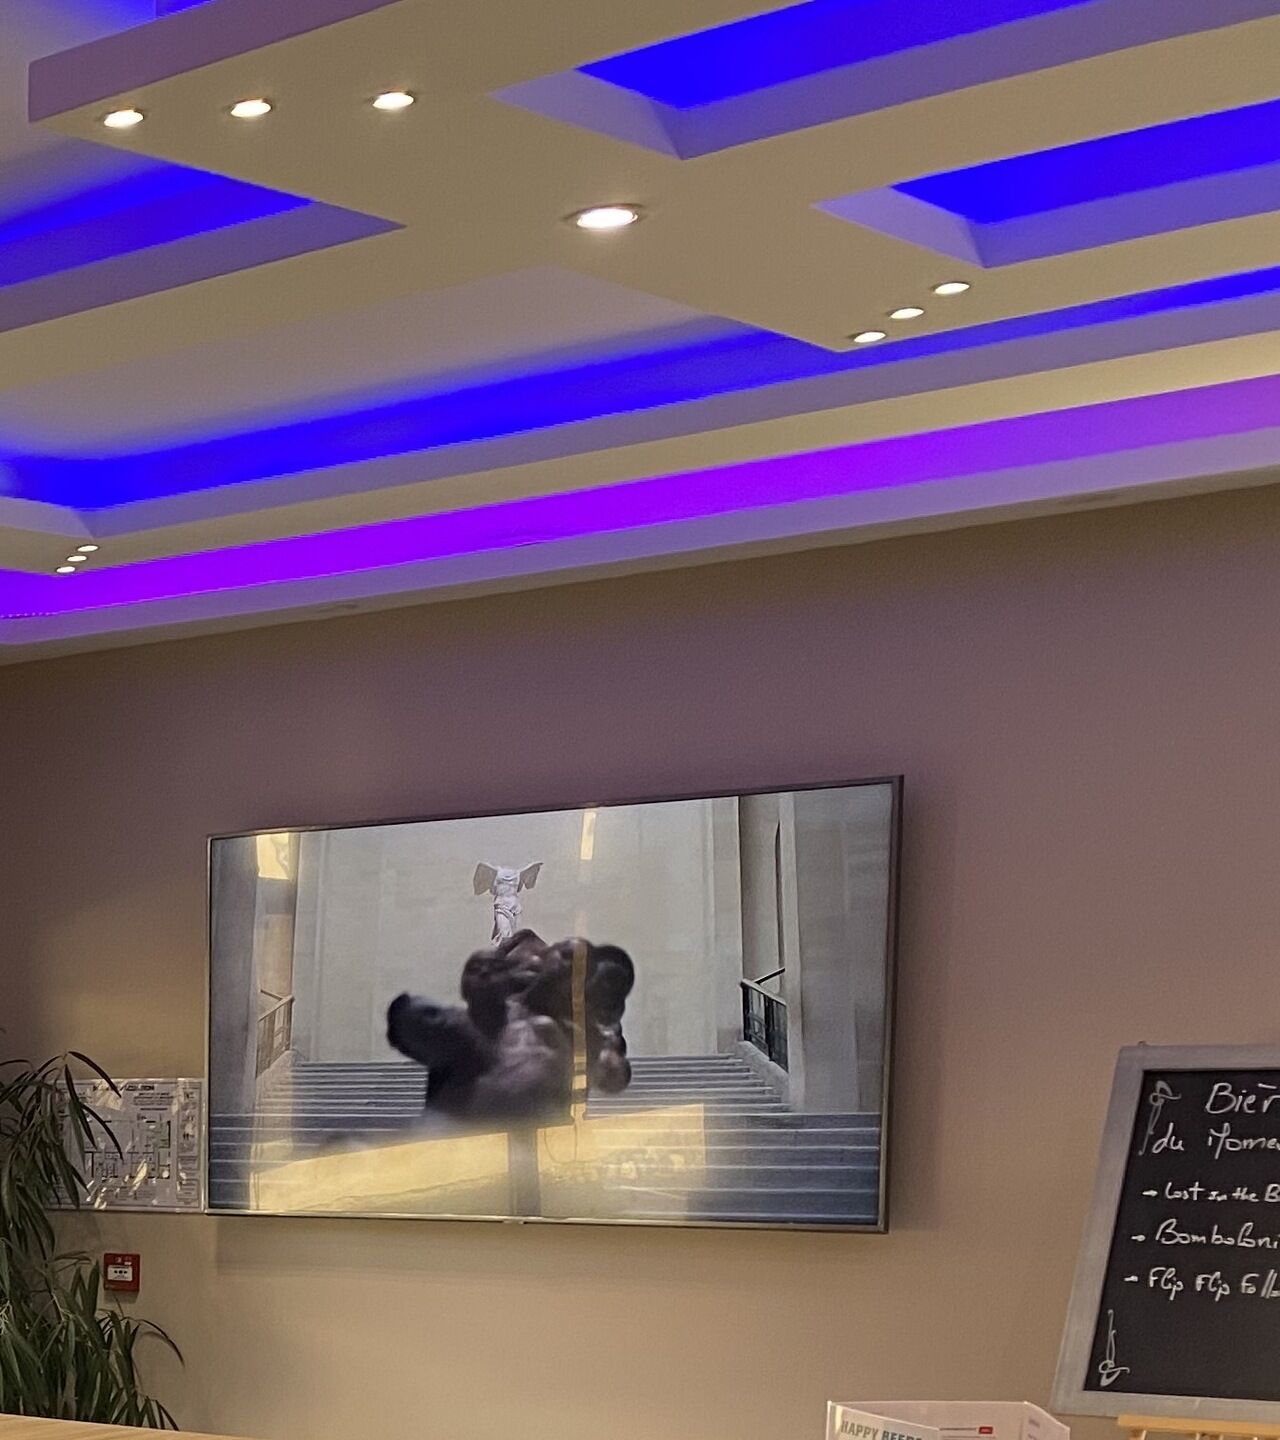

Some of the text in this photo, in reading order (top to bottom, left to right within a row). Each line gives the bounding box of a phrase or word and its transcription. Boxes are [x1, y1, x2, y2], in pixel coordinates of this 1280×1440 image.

[1152, 1122, 1185, 1154] du
[1232, 1187, 1259, 1202] the
[1149, 1267, 1184, 1301] Flip
[840, 1421, 879, 1440] HAPPY
